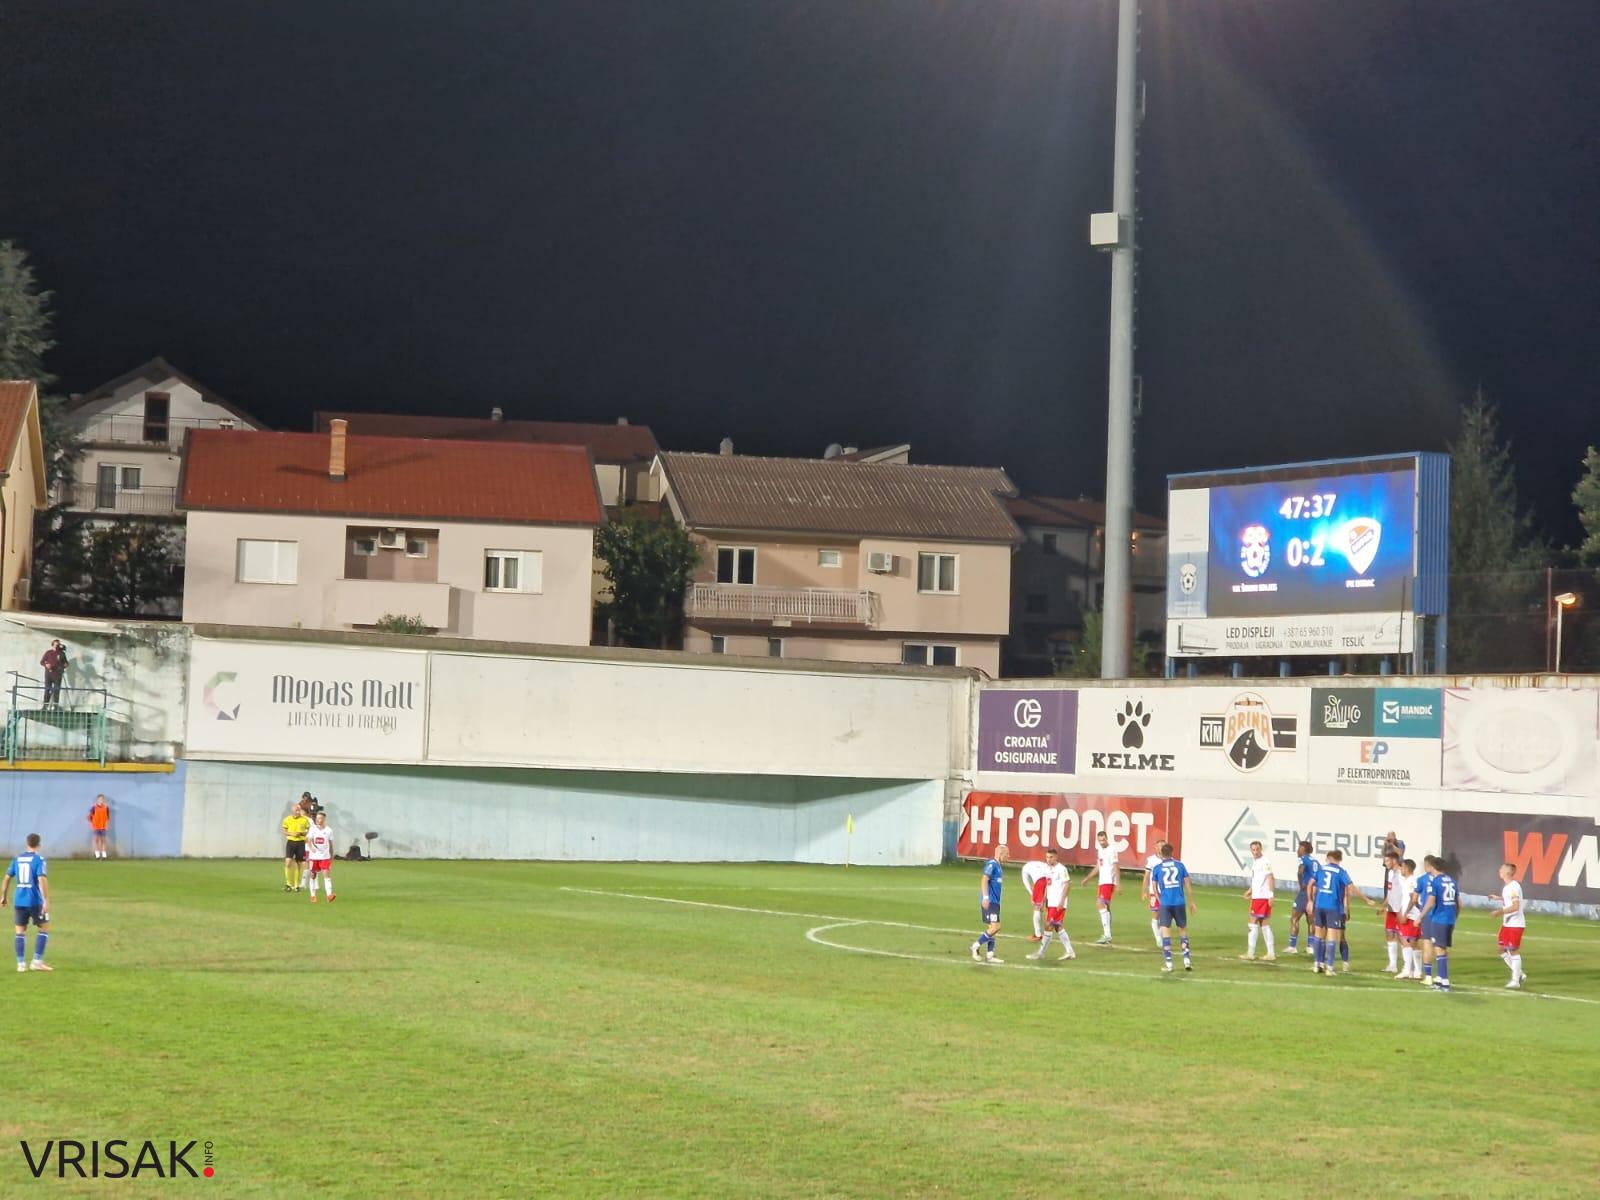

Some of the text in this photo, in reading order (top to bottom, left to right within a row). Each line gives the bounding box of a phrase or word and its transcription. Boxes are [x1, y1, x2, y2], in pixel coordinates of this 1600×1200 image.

[1279, 494, 1337, 519] 47:37
[1287, 537, 1325, 567] 0:2
[1225, 628, 1240, 638] LED
[1242, 626, 1275, 638] DISPLEJI
[1342, 634, 1365, 647] TESLIĆ
[272, 675, 414, 710] Mepas Mall
[1401, 704, 1433, 716] MANDIĆ
[1201, 719, 1223, 743] KTM
[1227, 711, 1272, 748] BRINA
[1004, 735, 1048, 749] CROATIA
[1360, 741, 1389, 763] EP
[994, 751, 1058, 764] OSIGURANJE
[1091, 752, 1175, 772] KELME
[1337, 767, 1411, 781] JP ELEKTROPRIVREDA
[970, 805, 1014, 845] HT
[1274, 829, 1386, 858] EMERUS
[18, 863, 30, 884] 11
[1162, 867, 1180, 885] 22
[1322, 871, 1333, 889] 3
